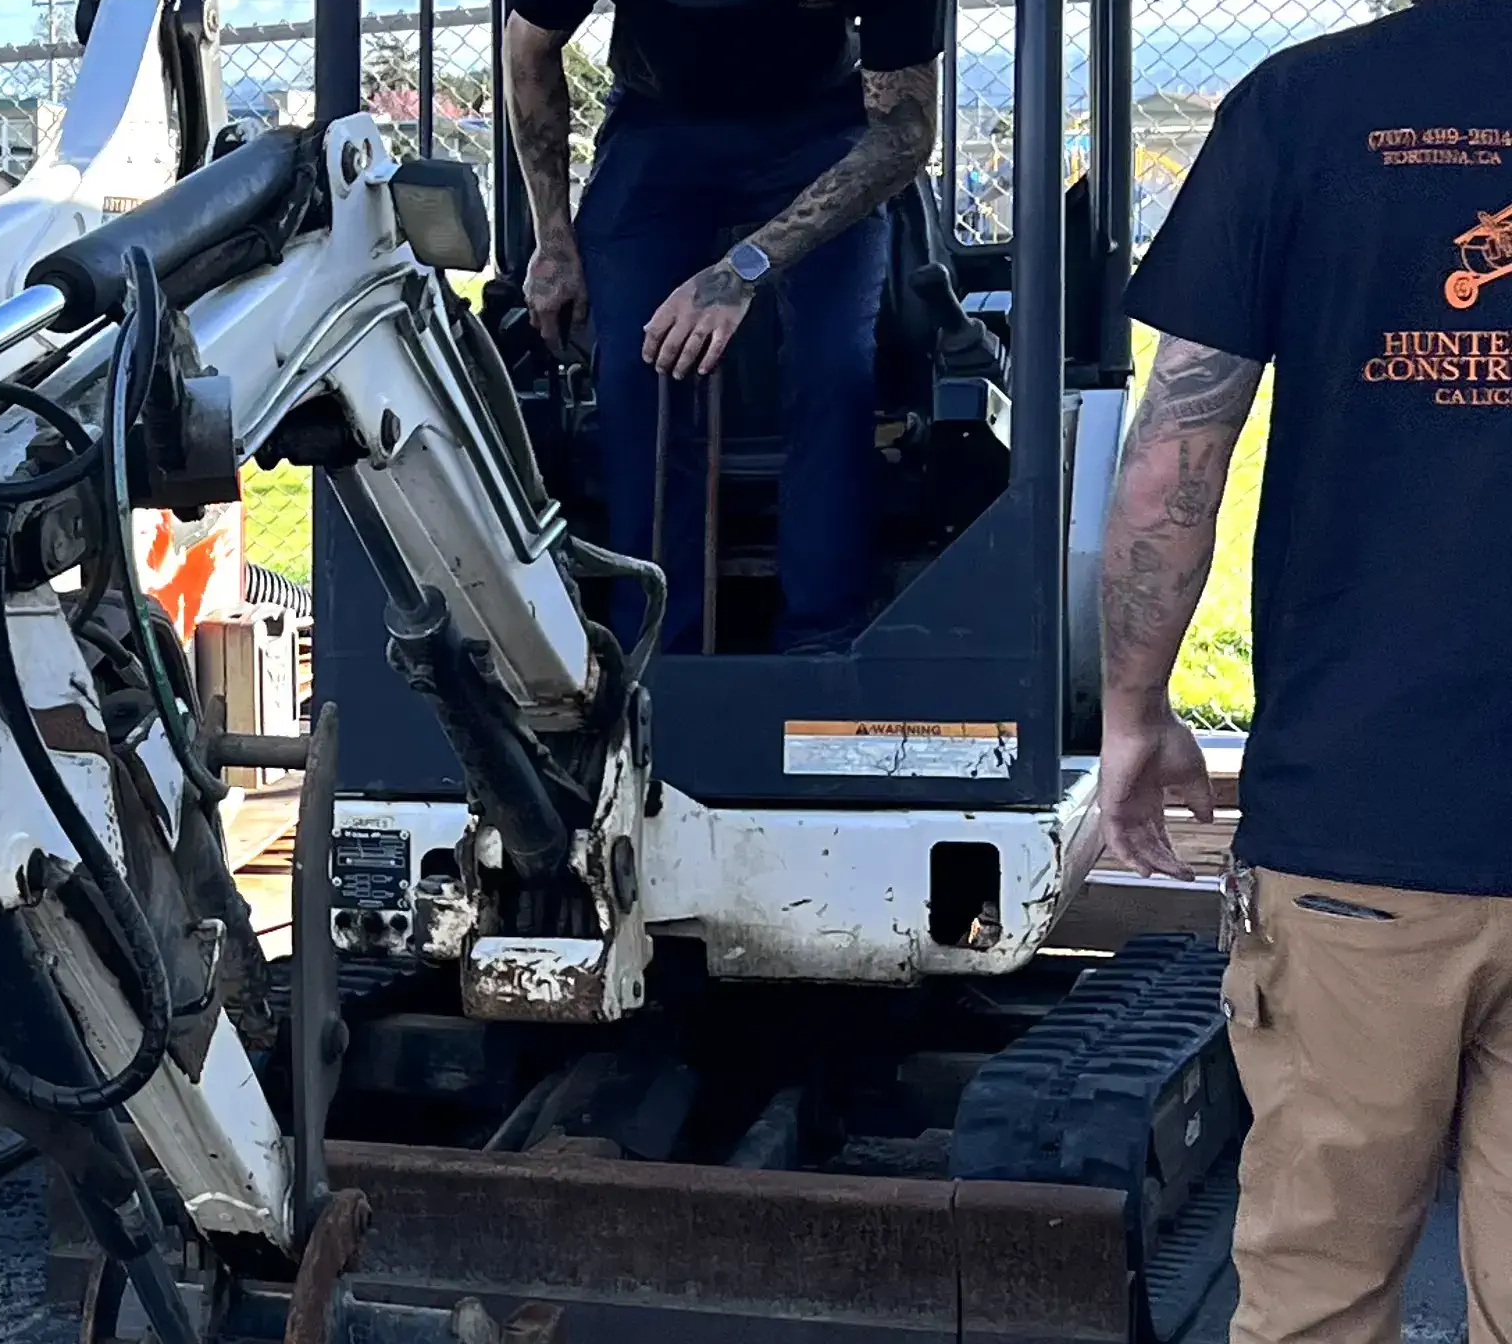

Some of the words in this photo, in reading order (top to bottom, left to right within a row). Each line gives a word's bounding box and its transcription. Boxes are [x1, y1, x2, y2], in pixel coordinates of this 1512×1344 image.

[1367, 128, 1416, 151] (707)
[1478, 150, 1502, 164] CA
[1383, 330, 1512, 356] HUNTE
[1363, 356, 1512, 382] CONSTR
[1434, 387, 1466, 405] CA
[1470, 387, 1512, 405] LIC
[869, 724, 942, 736] WARNING
